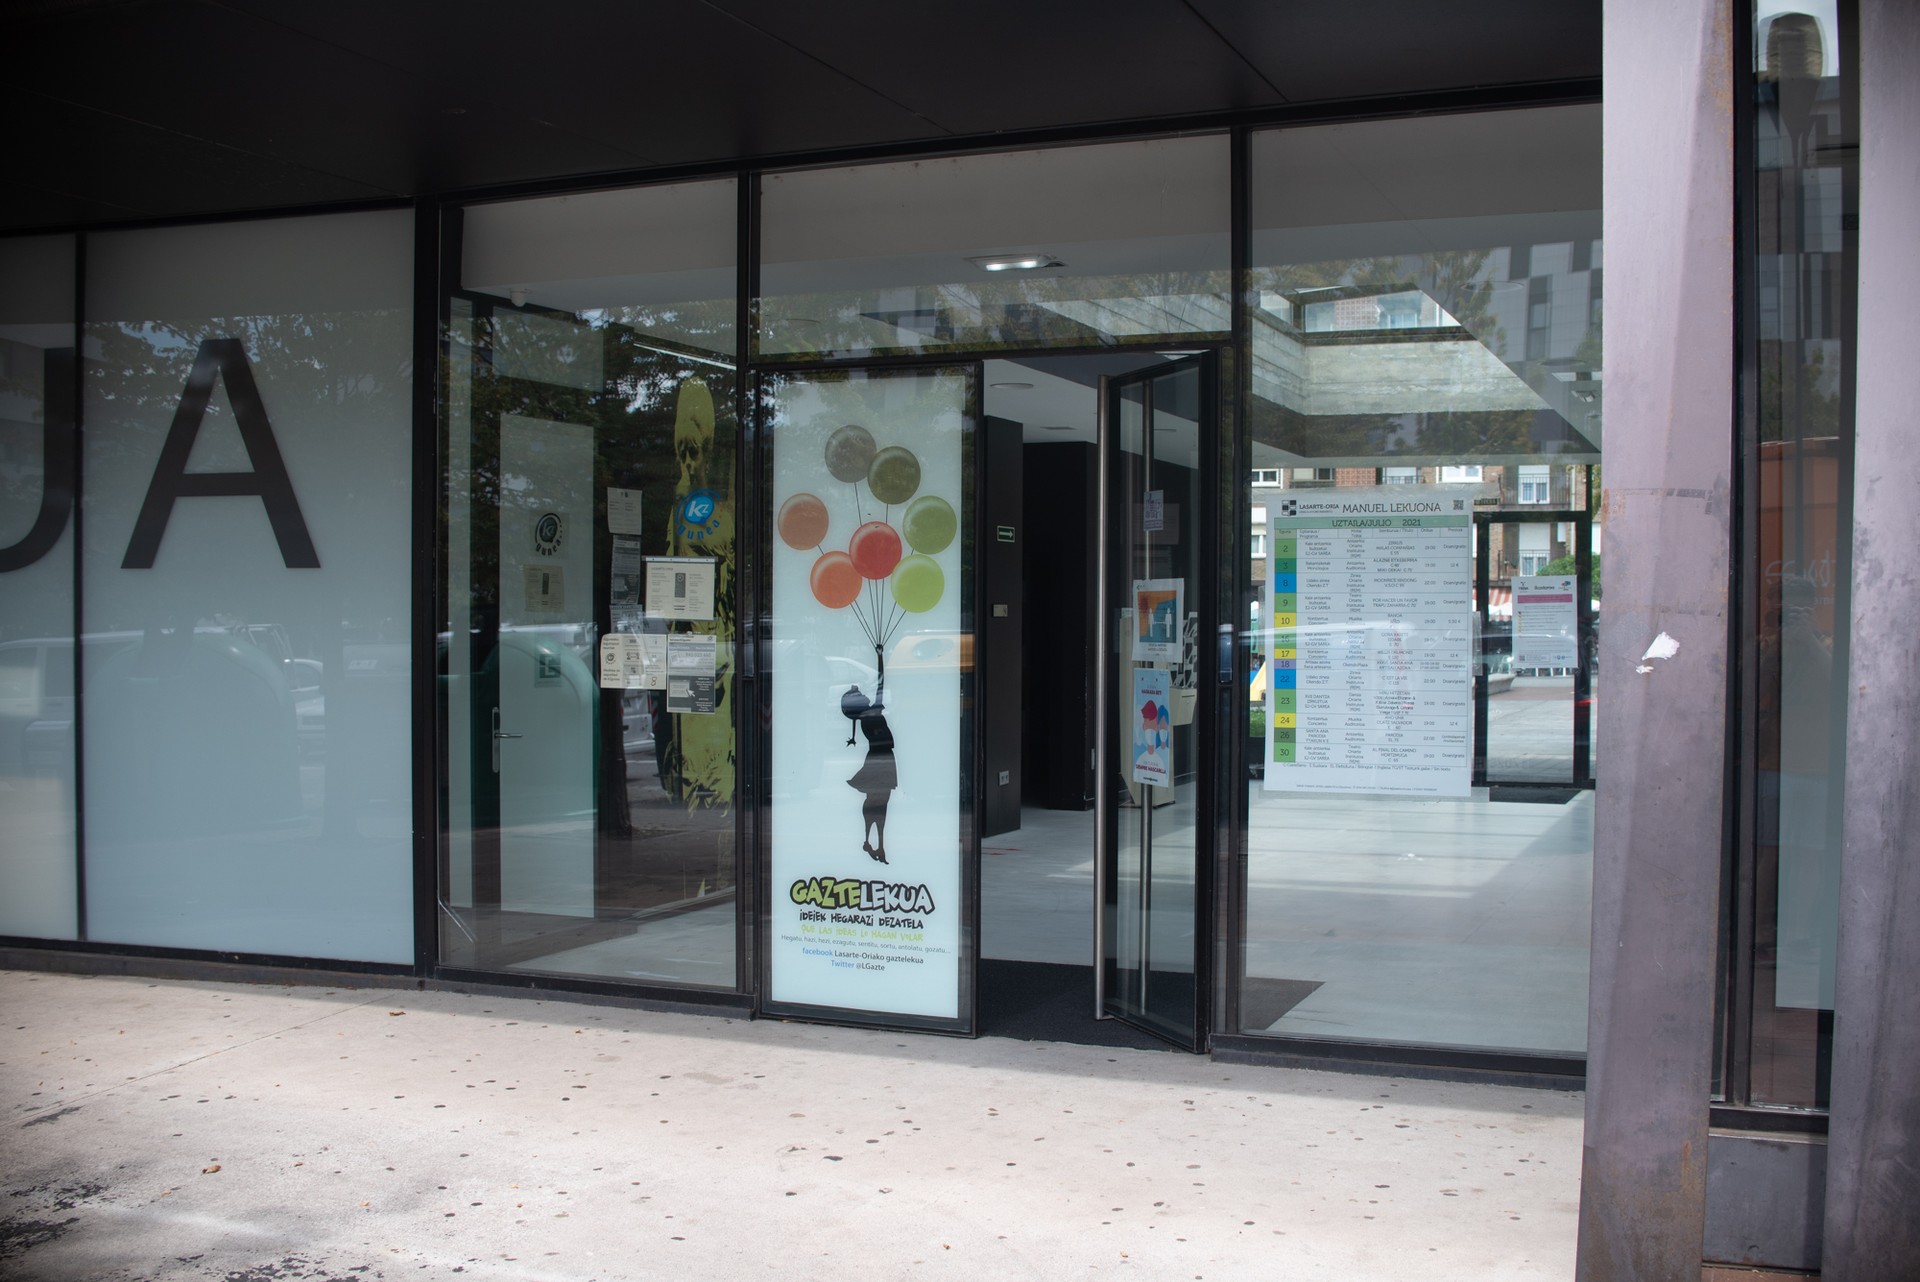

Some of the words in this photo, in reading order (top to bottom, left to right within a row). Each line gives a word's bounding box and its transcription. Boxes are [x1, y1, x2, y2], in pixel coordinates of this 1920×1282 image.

[1342, 503, 1388, 513] MANUEL
[1390, 502, 1442, 513] LEKUONA
[1332, 519, 1392, 528] UZTAILA/JULIO
[1402, 518, 1422, 527] 2021
[1282, 545, 1288, 553] 2
[1282, 562, 1288, 570] 3
[790, 876, 936, 915] GAZTELEKUA
[879, 916, 924, 930] DEZATELA
[802, 947, 834, 956] facebook
[834, 950, 885, 961] Lasarte-Oriako
[885, 955, 924, 964] gaztelekua
[831, 960, 854, 968] Twitter
[855, 962, 885, 971] @LGazte
